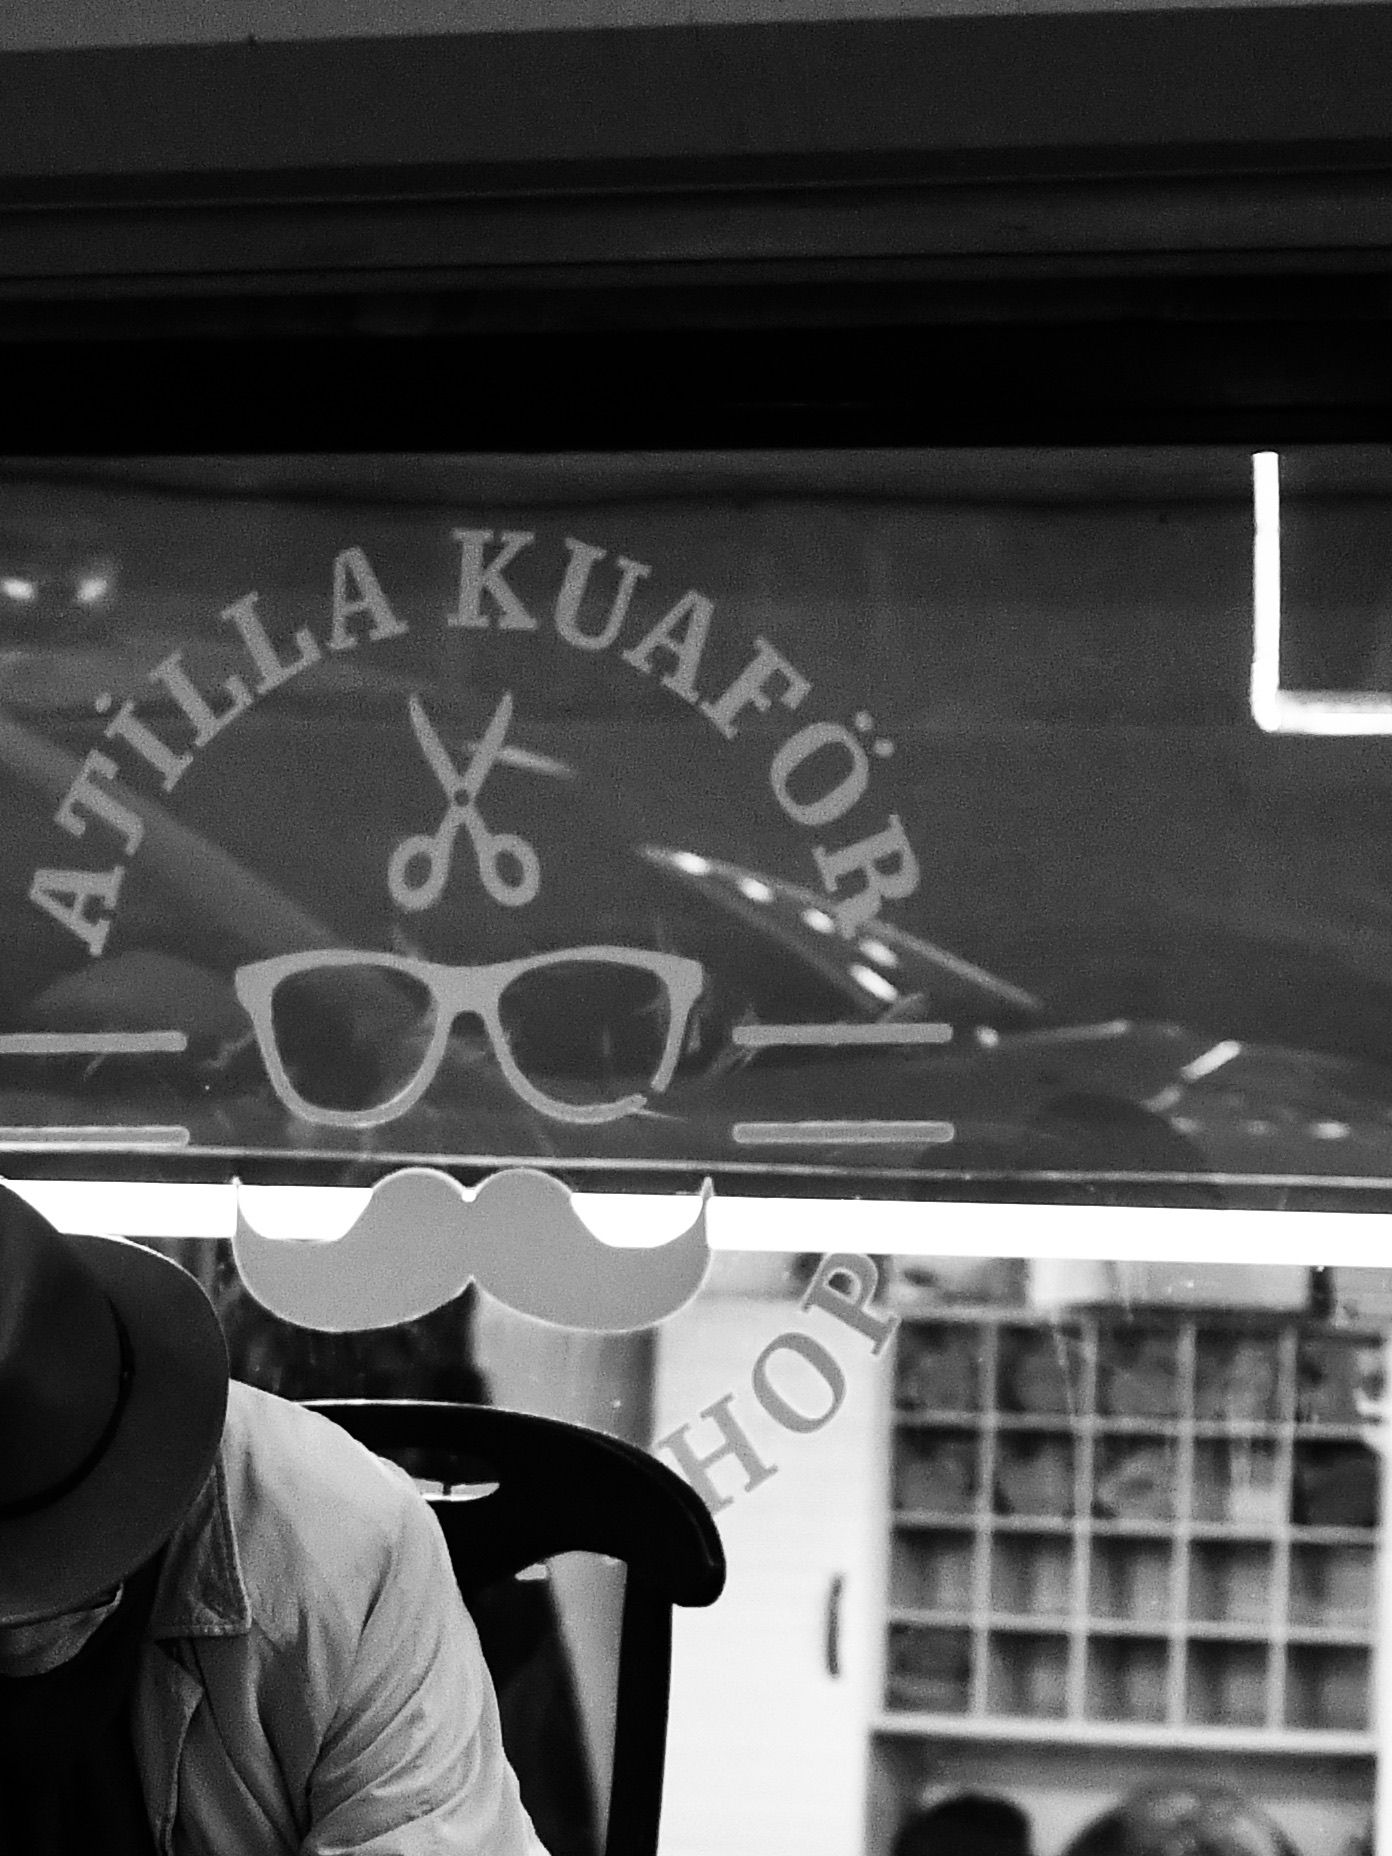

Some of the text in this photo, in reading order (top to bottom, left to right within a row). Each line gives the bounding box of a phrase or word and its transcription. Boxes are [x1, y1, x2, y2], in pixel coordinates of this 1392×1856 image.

[29, 527, 920, 955] ATİLLA KUAFÖR
[659, 1252, 901, 1515] HOP
